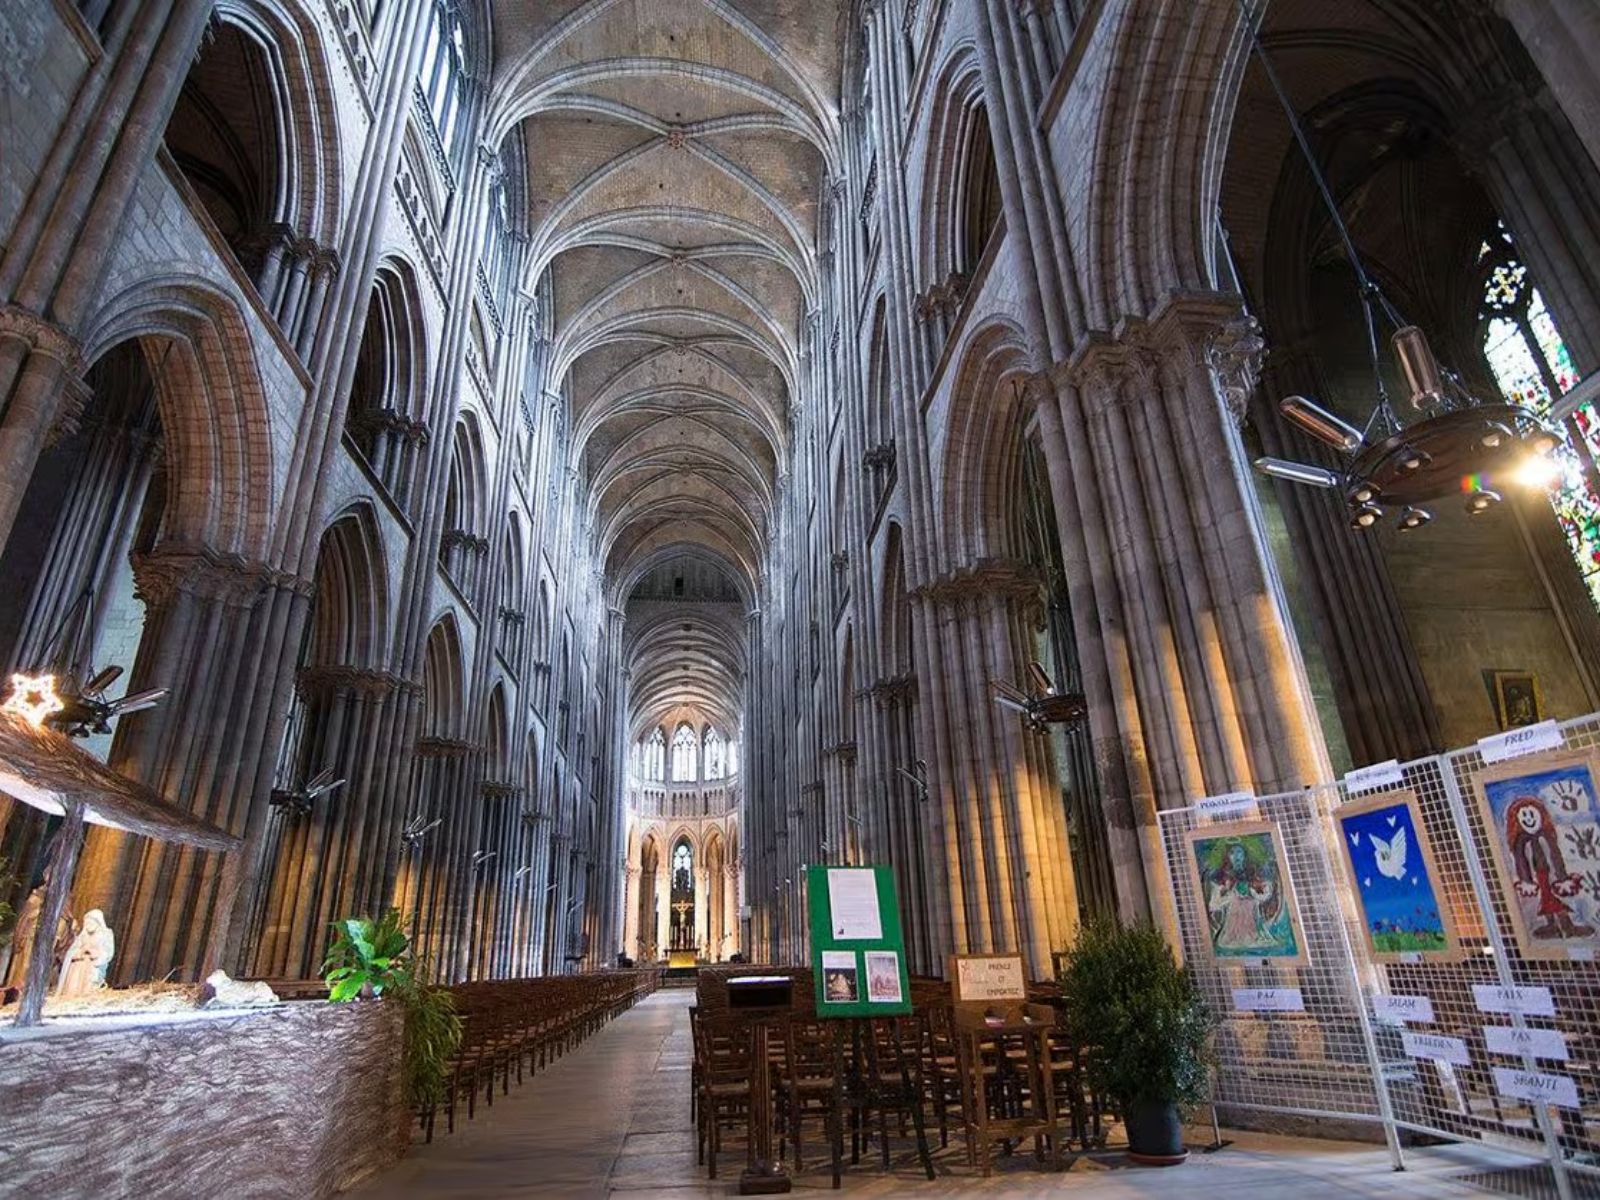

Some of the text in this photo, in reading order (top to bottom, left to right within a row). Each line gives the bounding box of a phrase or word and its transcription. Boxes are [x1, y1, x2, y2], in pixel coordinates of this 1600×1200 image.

[1503, 729, 1534, 747] FRED
[1496, 988, 1524, 1000] PAIX
[1386, 997, 1416, 1009] SALAM
[1510, 1029, 1532, 1042] PAX
[1512, 1073, 1557, 1091] SHANTI
